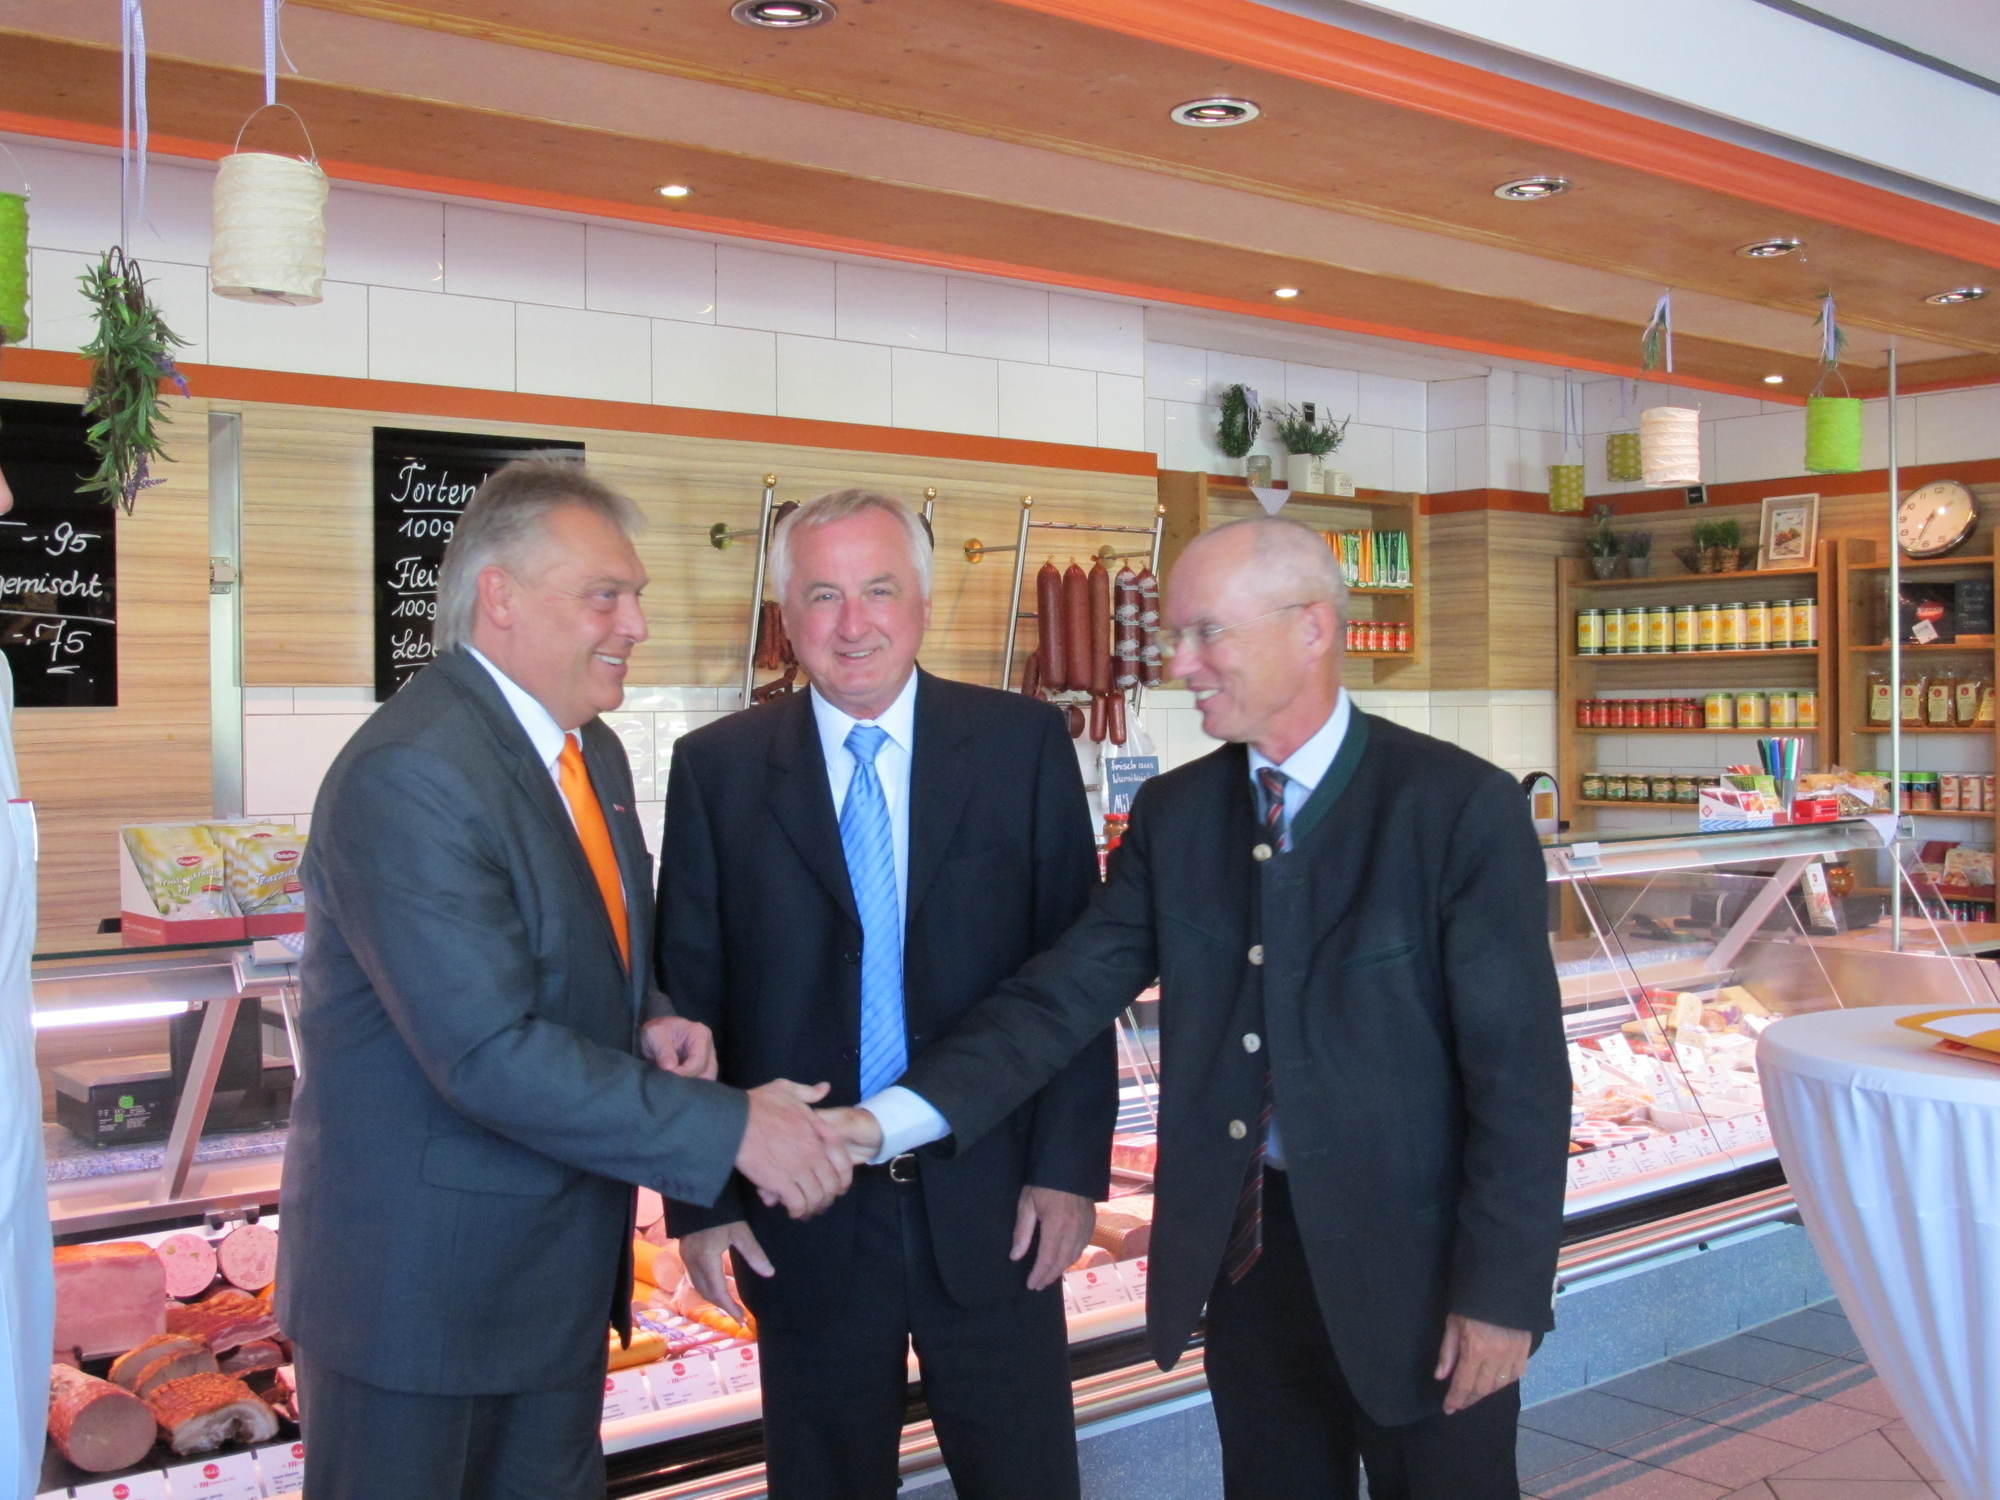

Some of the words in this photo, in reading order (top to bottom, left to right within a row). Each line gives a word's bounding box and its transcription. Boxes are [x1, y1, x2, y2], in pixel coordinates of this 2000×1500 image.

[398, 517, 455, 543] 100g
[387, 556, 441, 589] Flei
[391, 599, 438, 621] 100g
